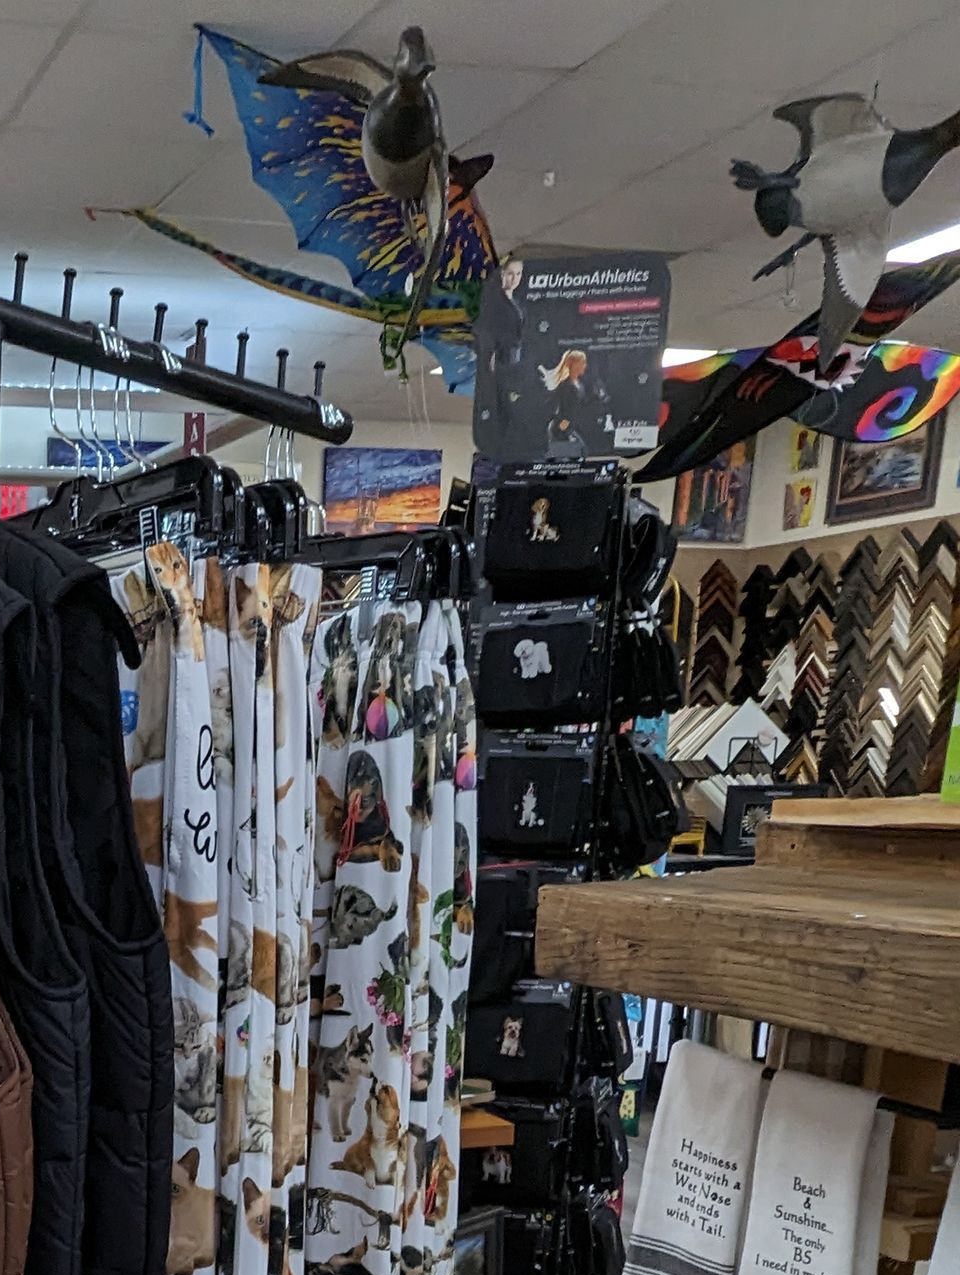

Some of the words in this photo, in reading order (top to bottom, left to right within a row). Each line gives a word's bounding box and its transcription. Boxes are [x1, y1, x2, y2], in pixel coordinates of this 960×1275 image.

[548, 267, 650, 288] UrbanAthletics
[681, 1138, 738, 1171] Happiness
[672, 1159, 702, 1178] starts
[704, 1171, 729, 1188] with
[733, 1181, 741, 1191] a
[793, 1176, 826, 1199] Beach
[675, 1171, 698, 1194] Wet
[698, 1182, 732, 1206] Nose
[677, 1194, 696, 1209] and
[696, 1203, 720, 1219] ends
[803, 1197, 812, 1210] &
[666, 1208, 690, 1223] with
[699, 1215, 726, 1239] Tail.
[782, 1227, 803, 1246] The
[804, 1238, 826, 1254] only
[755, 1253, 760, 1265] I
[762, 1258, 788, 1273] need
[792, 1246, 813, 1265] BS
